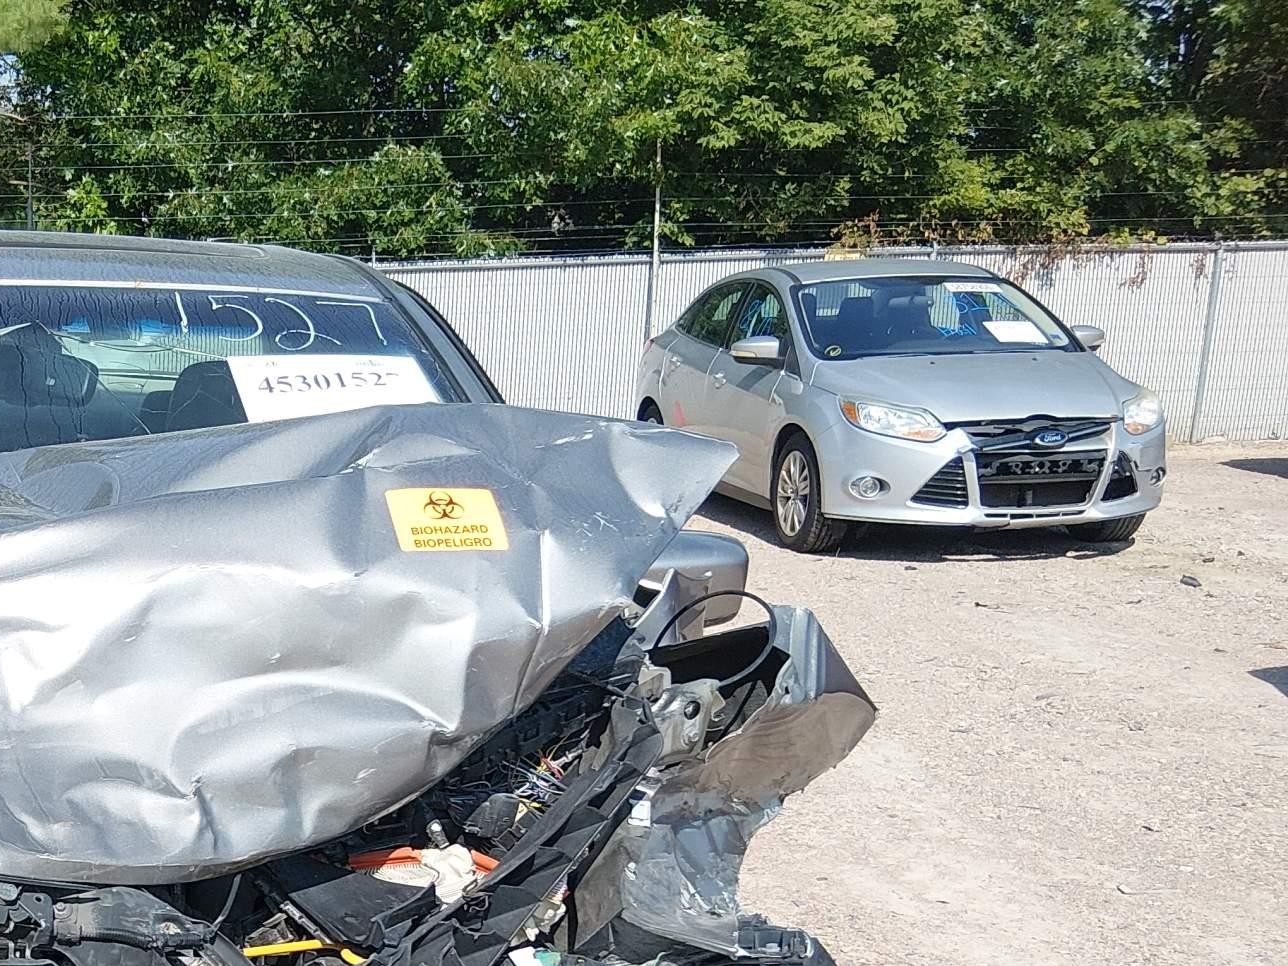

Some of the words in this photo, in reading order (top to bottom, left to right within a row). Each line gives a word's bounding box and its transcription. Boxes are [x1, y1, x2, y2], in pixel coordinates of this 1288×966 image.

[174, 291, 388, 351] 1527
[410, 524, 489, 536] BIOHAZARD
[414, 537, 493, 548] BIOPELIGRO
